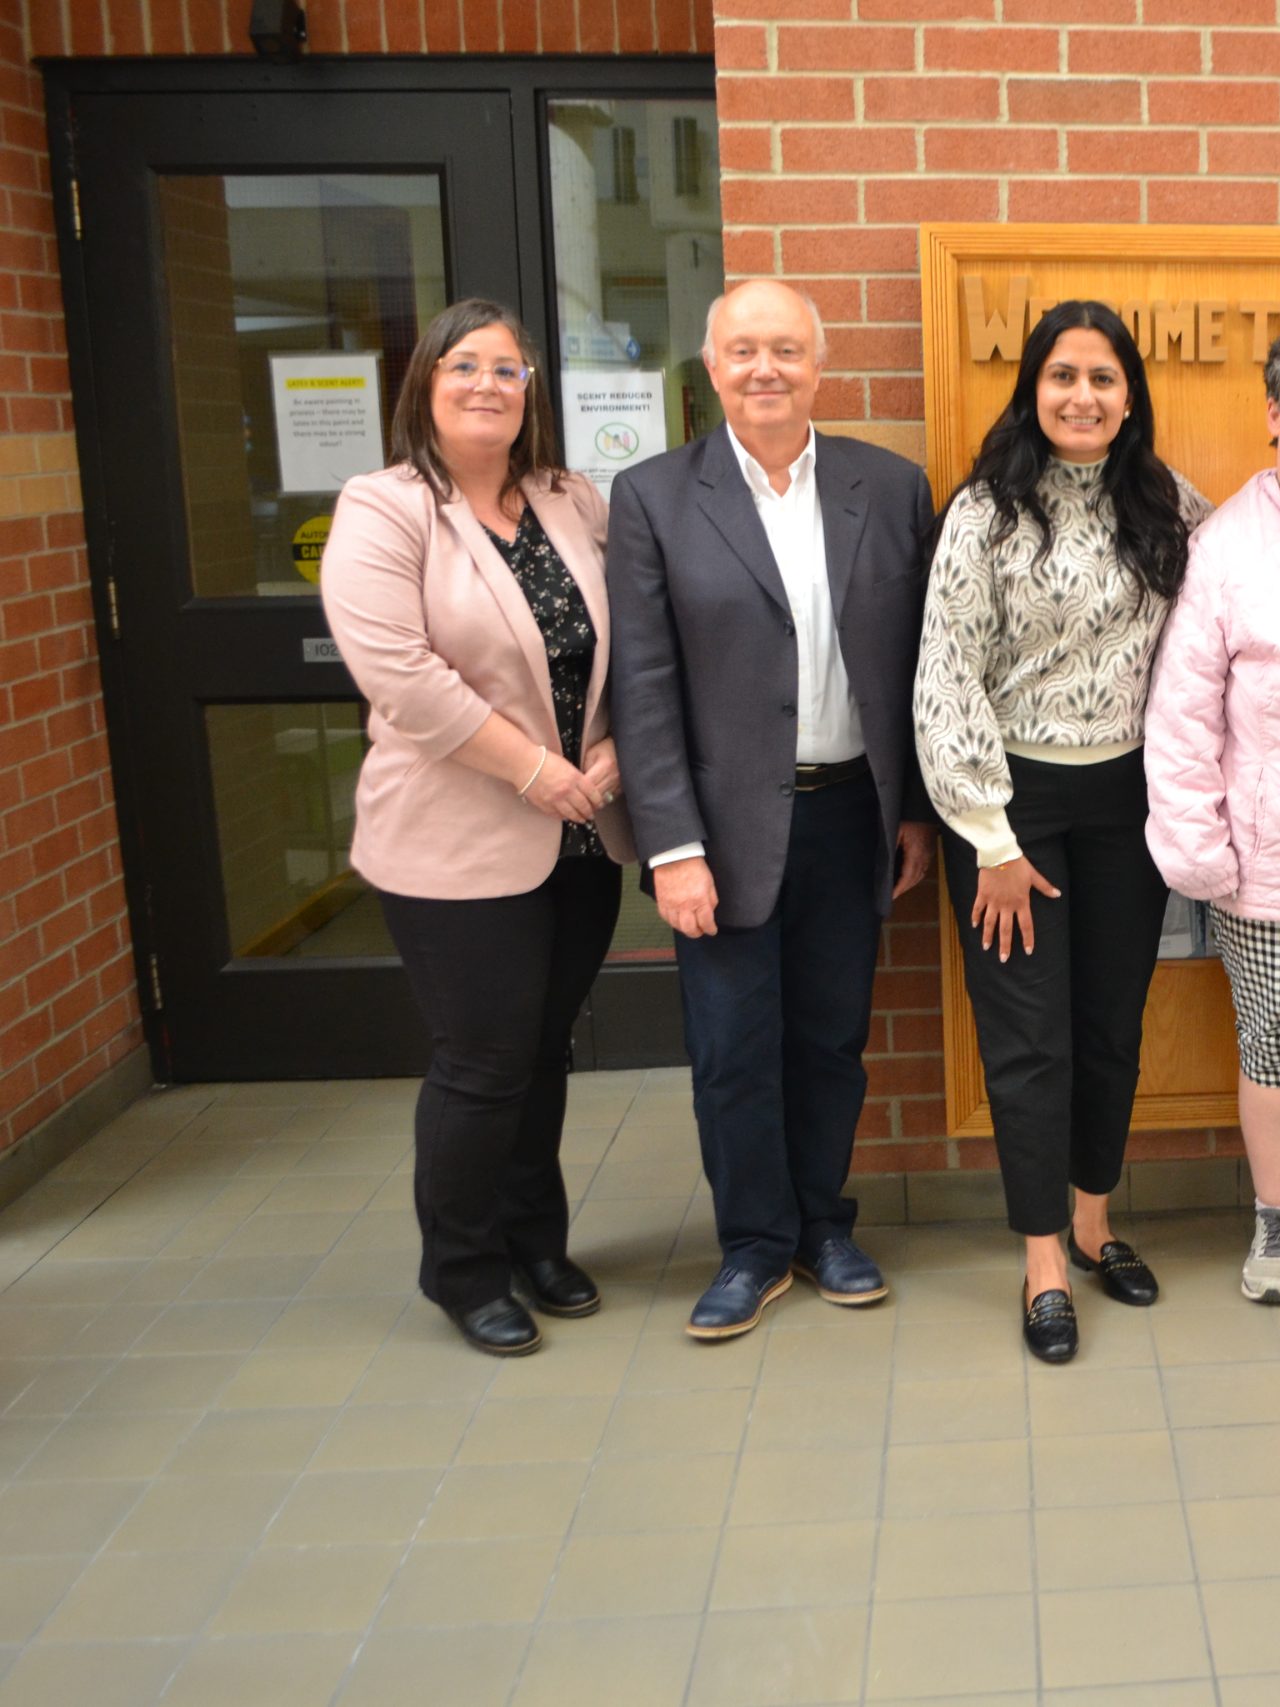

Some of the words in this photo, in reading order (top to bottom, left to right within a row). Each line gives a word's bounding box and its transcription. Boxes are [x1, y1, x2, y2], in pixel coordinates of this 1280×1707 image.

[963, 275, 1227, 362] WOME
[577, 392, 607, 400] SCENT
[610, 391, 652, 400] REDUCED
[580, 404, 650, 413] ENVIRONMENT!
